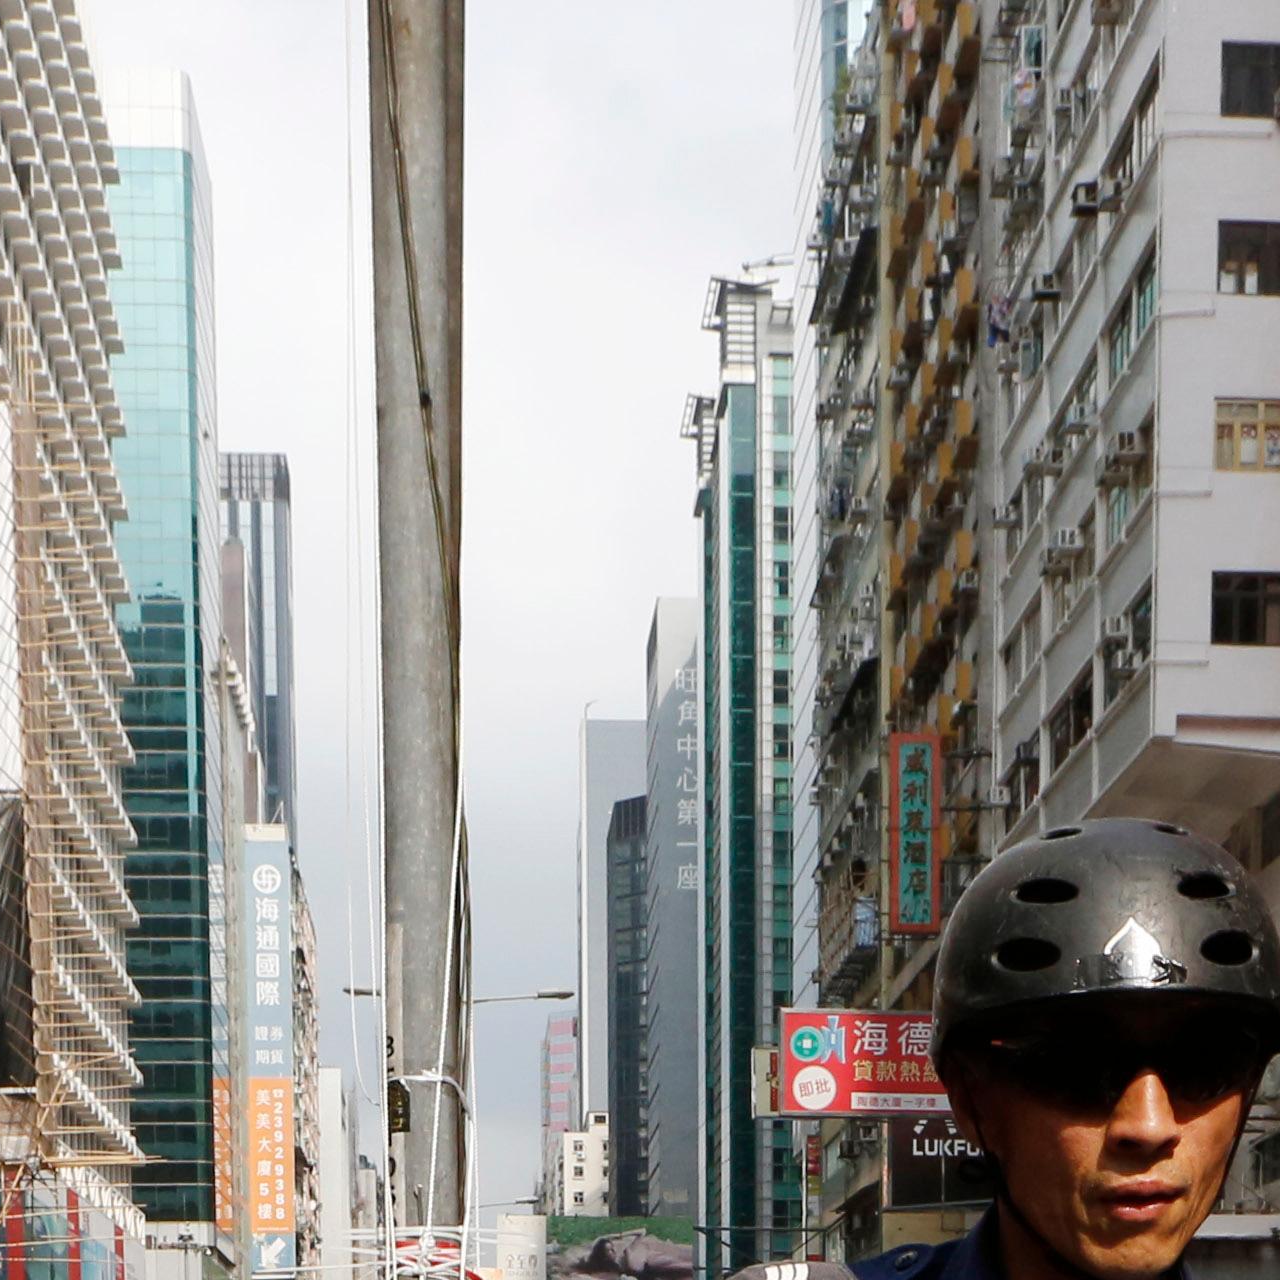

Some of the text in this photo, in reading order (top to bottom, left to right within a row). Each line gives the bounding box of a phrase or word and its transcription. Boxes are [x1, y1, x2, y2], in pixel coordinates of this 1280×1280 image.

[675, 668, 699, 891] 旺角中心第一座
[255, 897, 281, 1007] 海通國際
[255, 1049, 284, 1066] 期貨
[798, 1079, 832, 1098] 即批
[255, 1088, 274, 1221] 美美大廈5樓
